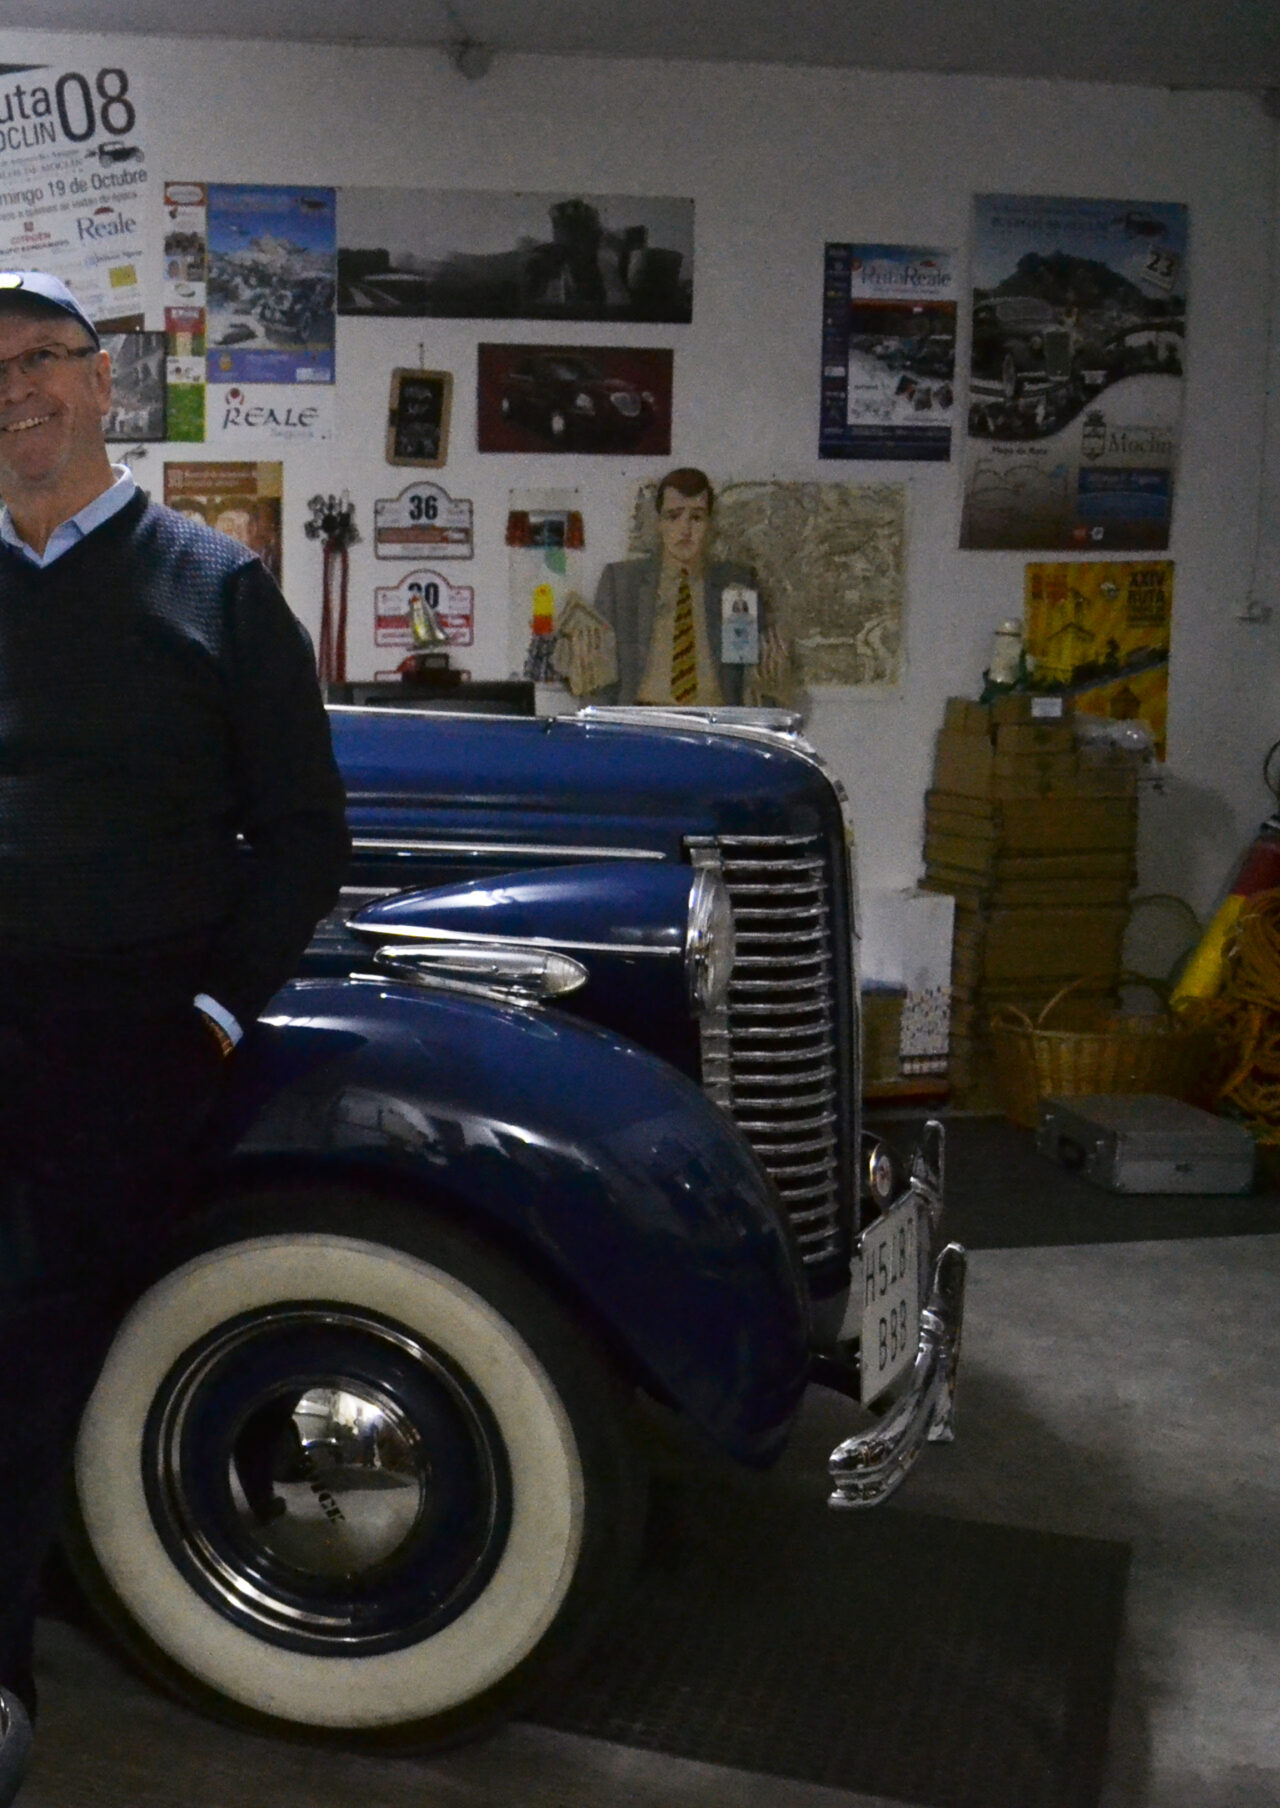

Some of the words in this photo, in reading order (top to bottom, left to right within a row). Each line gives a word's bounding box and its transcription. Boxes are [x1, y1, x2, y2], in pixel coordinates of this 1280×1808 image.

[55, 68, 136, 142] 08
[48, 180, 66, 197] 19
[69, 178, 88, 194] de
[91, 168, 148, 190] Octubre
[77, 211, 137, 241] Reale
[223, 406, 320, 430] REALE
[409, 494, 438, 520] 36
